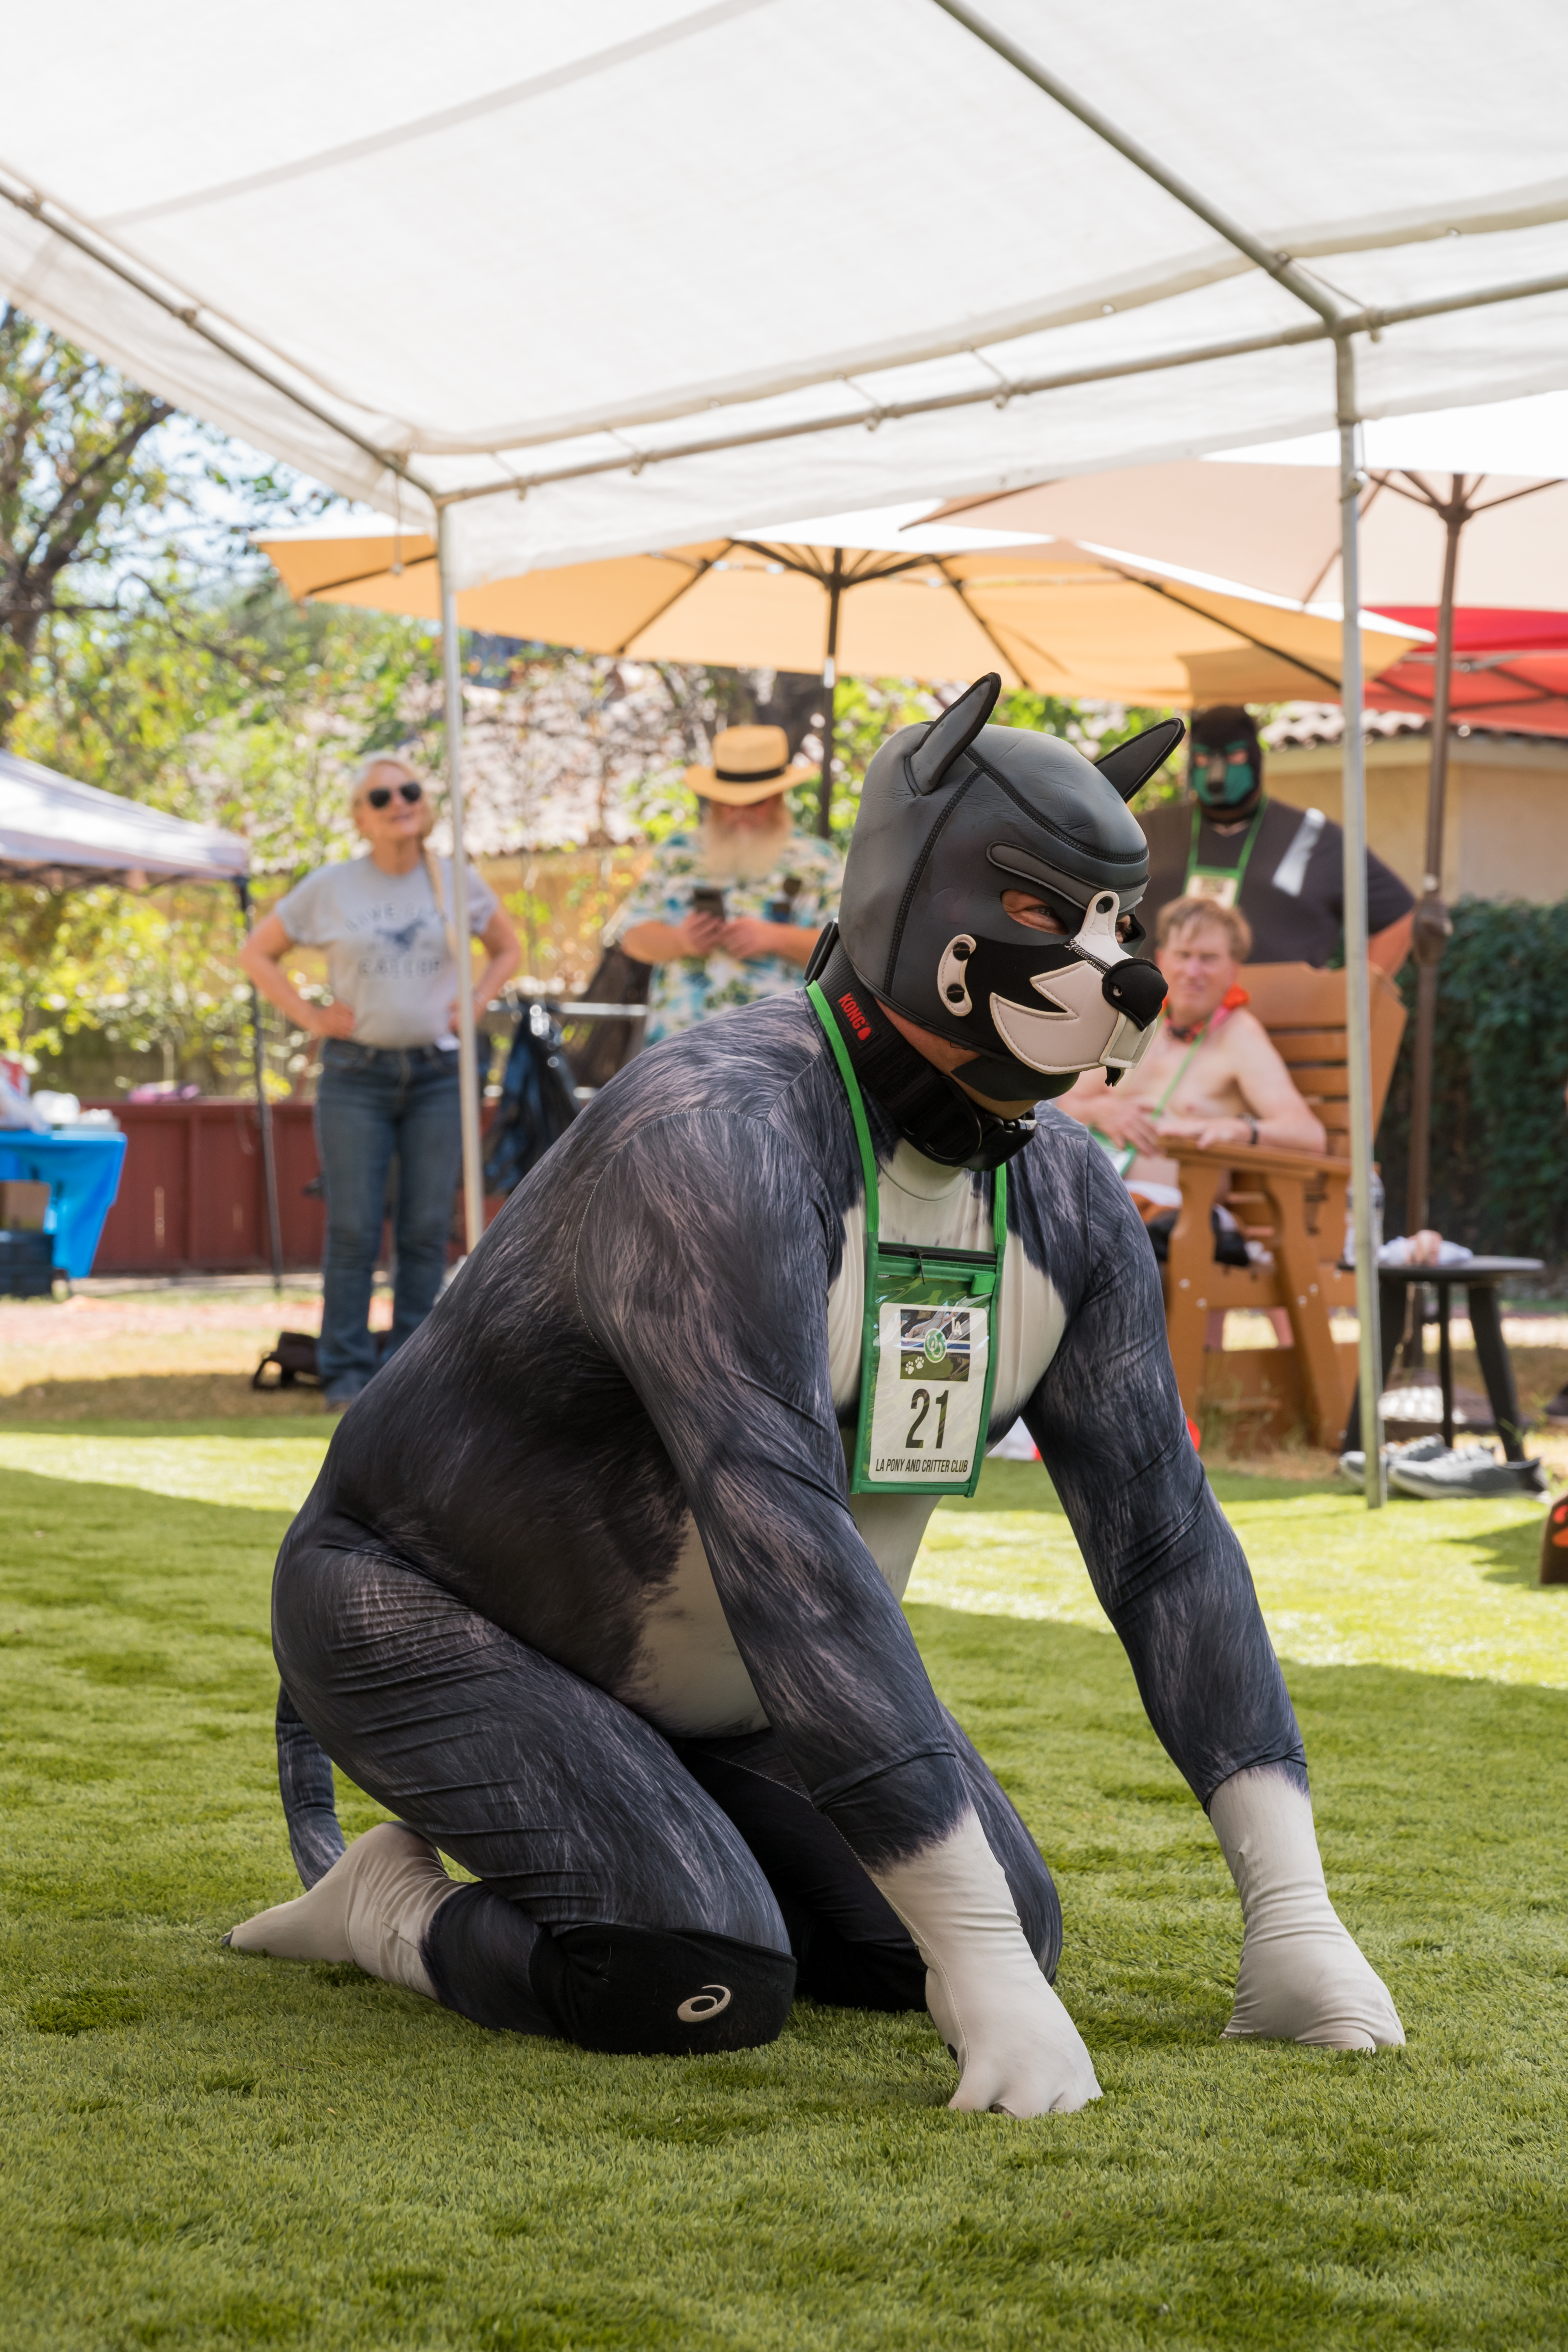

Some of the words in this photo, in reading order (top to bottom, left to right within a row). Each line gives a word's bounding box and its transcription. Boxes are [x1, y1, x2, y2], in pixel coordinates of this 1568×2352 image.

[838, 992, 866, 1029] KONG
[951, 1317, 962, 1335] LA
[905, 1388, 949, 1449] 21
[875, 1459, 884, 1472] LA
[886, 1459, 905, 1472] PONY
[905, 1459, 921, 1472] AND
[921, 1459, 950, 1472] CRITTER
[951, 1460, 968, 1472] CLUB
